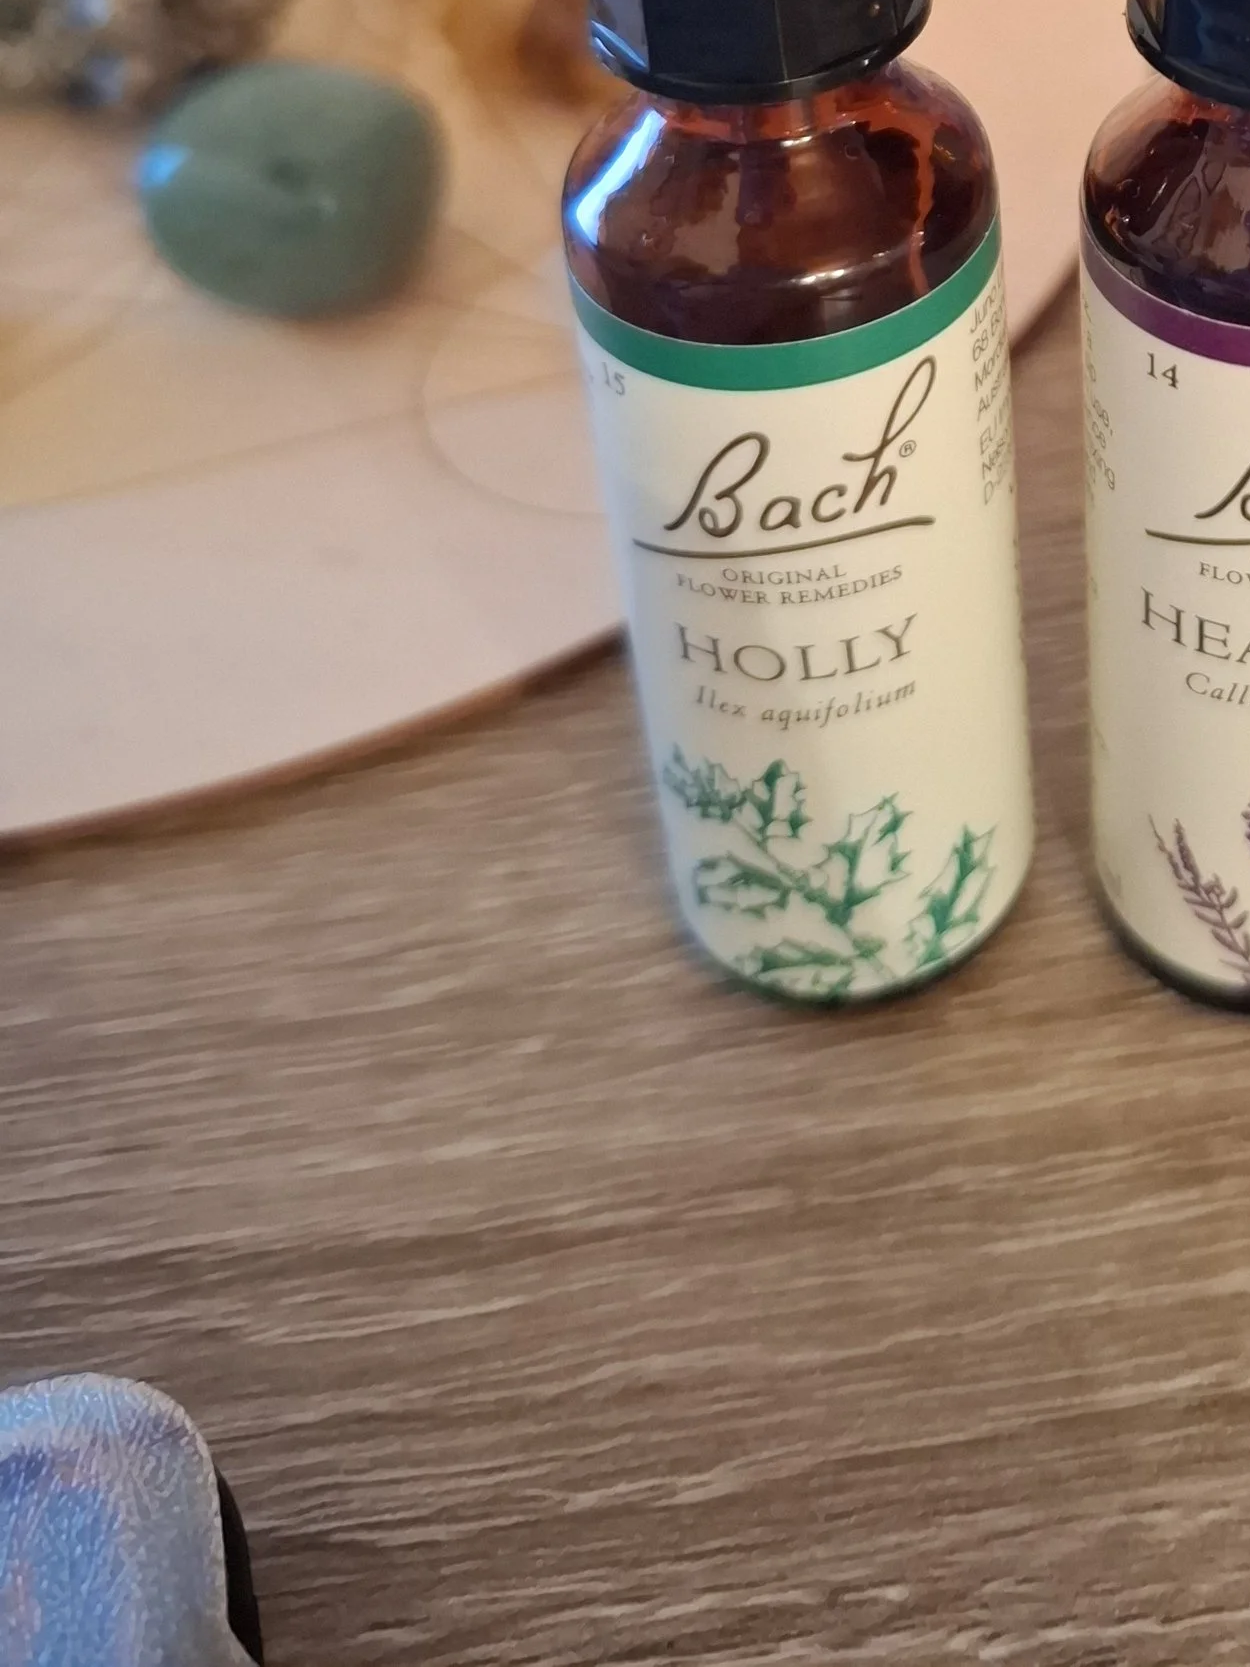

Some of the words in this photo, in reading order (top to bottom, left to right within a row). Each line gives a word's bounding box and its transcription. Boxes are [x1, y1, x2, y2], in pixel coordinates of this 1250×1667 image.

[601, 362, 626, 395] 15
[1147, 352, 1179, 390] 14
[677, 573, 770, 605] FLOWER
[781, 565, 903, 605] REMEDIES
[722, 564, 847, 585] ORIGINAL
[675, 613, 918, 682] HOLLY
[761, 681, 916, 731] aquifolium
